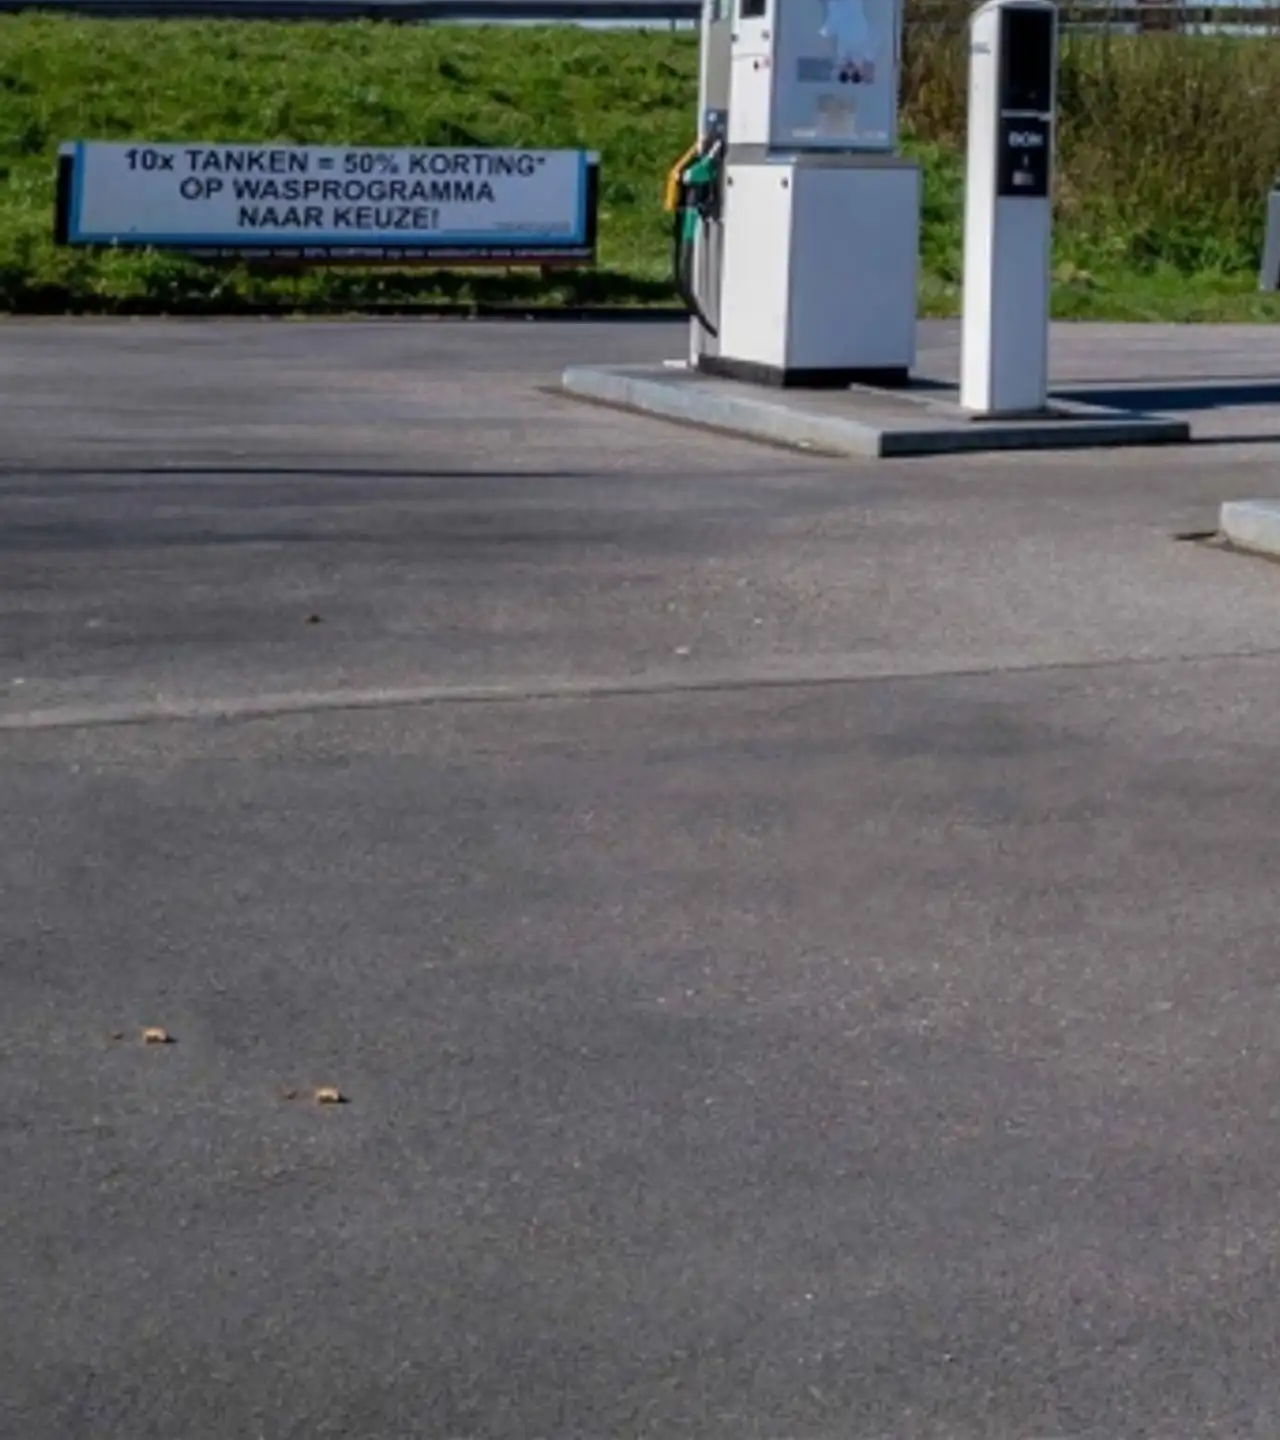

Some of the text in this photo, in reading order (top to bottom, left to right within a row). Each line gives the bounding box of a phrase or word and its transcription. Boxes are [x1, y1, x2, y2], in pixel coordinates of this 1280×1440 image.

[125, 148, 175, 171] 10x
[185, 149, 309, 174] TANKEN
[343, 152, 399, 175] 50%
[180, 176, 496, 203] OP WASPROGRAMMA
[237, 205, 440, 230] NAAR KEUZE!
